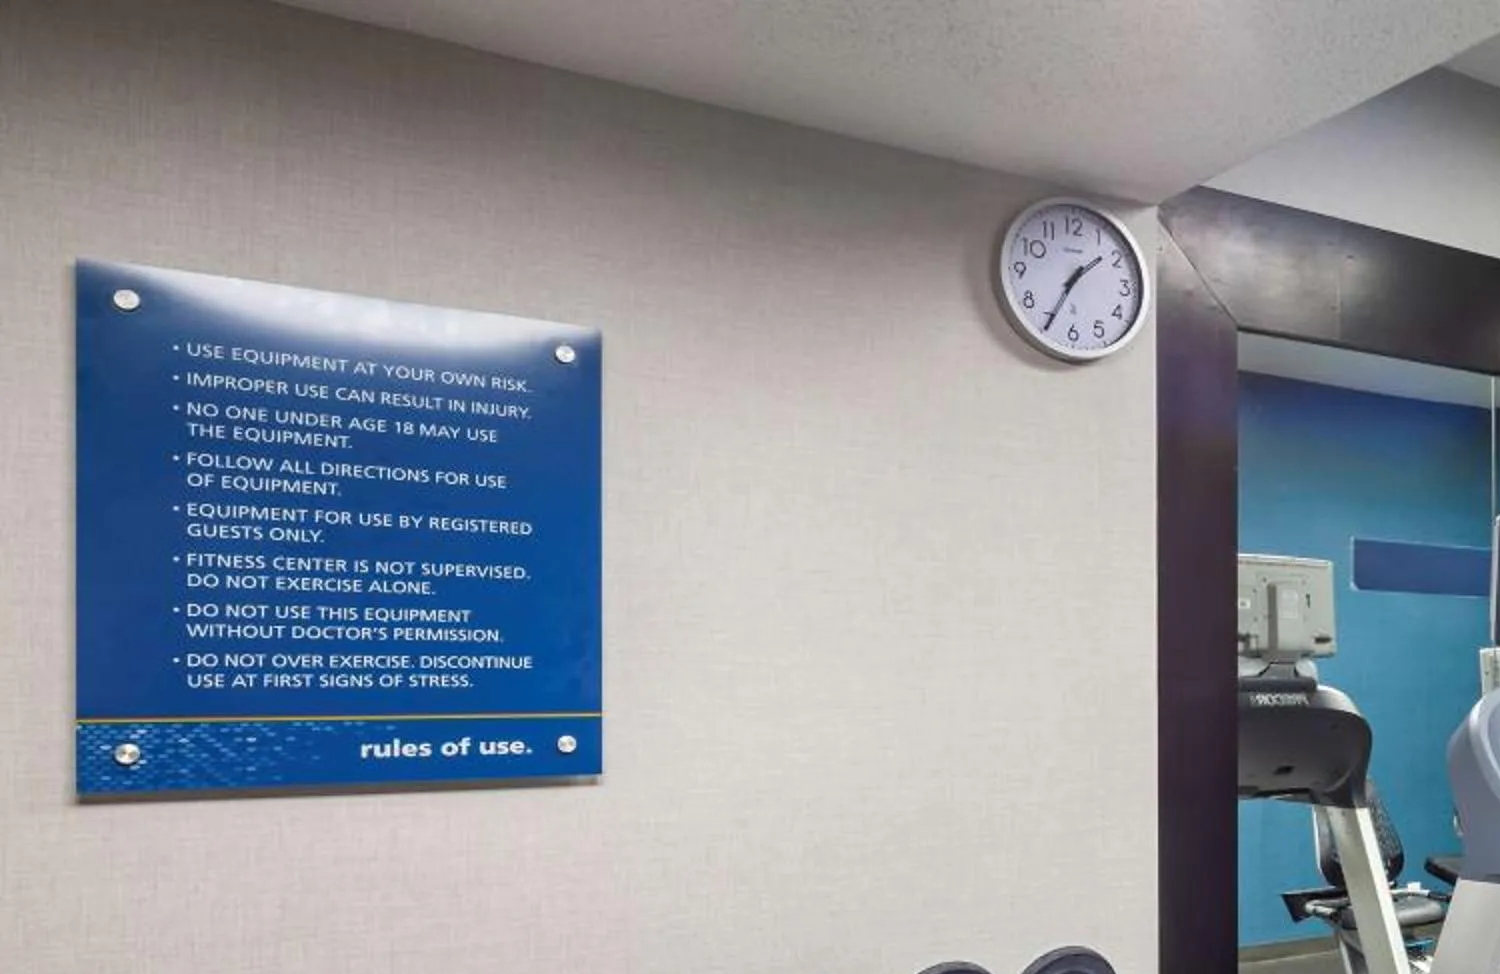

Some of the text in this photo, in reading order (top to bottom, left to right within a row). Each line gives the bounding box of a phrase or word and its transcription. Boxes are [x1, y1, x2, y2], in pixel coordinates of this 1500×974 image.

[1043, 220, 1055, 240] 11
[1066, 215, 1083, 236] 12
[1095, 228, 1101, 246] 1
[1022, 237, 1047, 259] 10
[1111, 250, 1122, 268] 2
[1013, 261, 1027, 279] 9
[1119, 279, 1131, 297] 3
[1023, 290, 1035, 309] 8
[1111, 304, 1123, 320] 4
[1067, 324, 1080, 341] 6
[1093, 320, 1105, 338] 5
[187, 342, 534, 393] USE EQUIPMENT AT YOUR OWN RISK.
[187, 372, 532, 420] IMPROPER USE CAN RESULT IN INJURY.
[187, 402, 498, 443] NO ONE UNDER AGE 18 MAY USE
[187, 422, 353, 449] THE EQUIPMENT.
[187, 451, 507, 489] FOLLOW ALL DIRECTIONS FOR USE
[187, 473, 342, 496] OF EQUIPMENT.
[187, 503, 533, 535] EQUIPMENT FOR USE BY REGISTERED
[187, 523, 325, 543] GUESTS ONLY.
[187, 553, 531, 580] FITNESS CENTER IS NOT SUPERVISED.
[187, 573, 436, 595] DO NOT EXERCISE ALONE.
[187, 603, 472, 623] DO NOT USE THIS EQUIPMENT
[186, 623, 504, 643] WITHOUT DOCTOR'S PERMISSION.
[187, 653, 533, 669] DO NOT OVER EXERCISE. DISCONTINUE
[187, 674, 474, 688] USE AT FIRST SIGNS OF STRESS.
[360, 737, 533, 758] rules of use.
